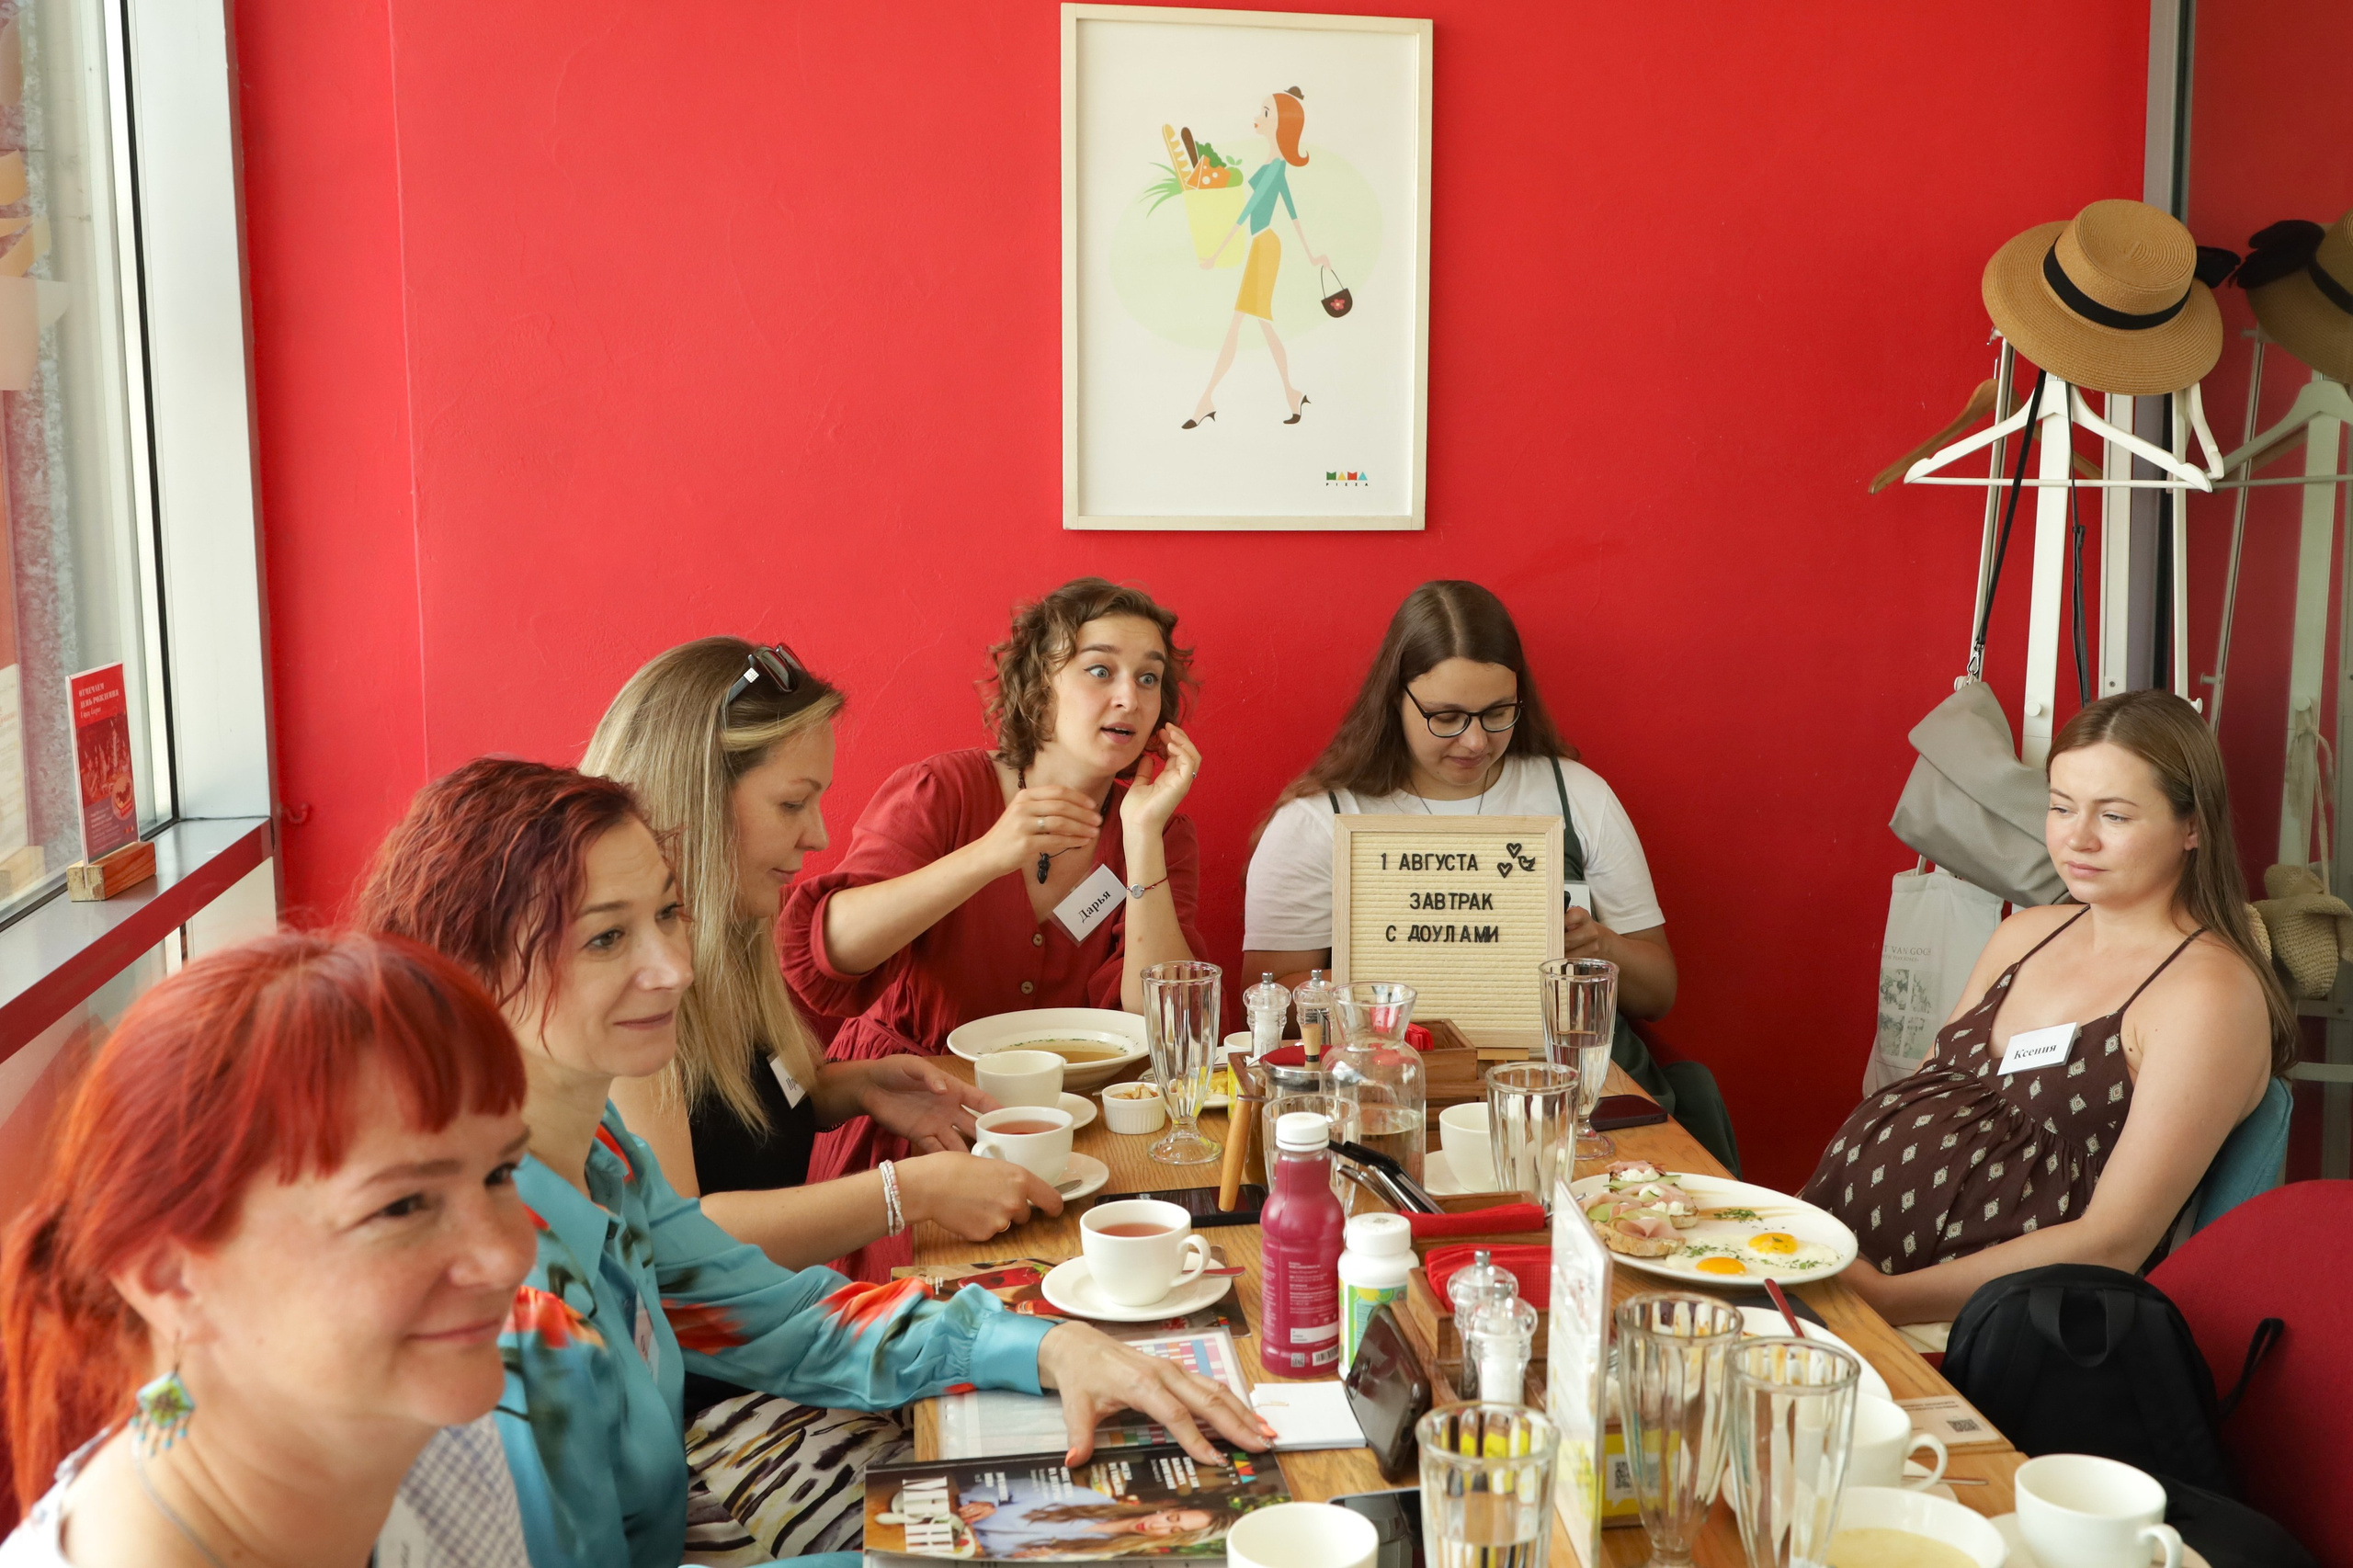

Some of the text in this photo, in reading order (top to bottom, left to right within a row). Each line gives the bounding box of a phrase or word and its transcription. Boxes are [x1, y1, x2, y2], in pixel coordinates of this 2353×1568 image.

[1381, 853, 1478, 871] 1 АВГУСТА
[1078, 891, 1111, 923] Дарья
[1409, 892, 1494, 910] ЗАВТРАК
[1385, 925, 1499, 943] С ДОУЛАМИ
[1892, 946, 1909, 954] VAN
[2013, 1044, 2057, 1060] Ксения
